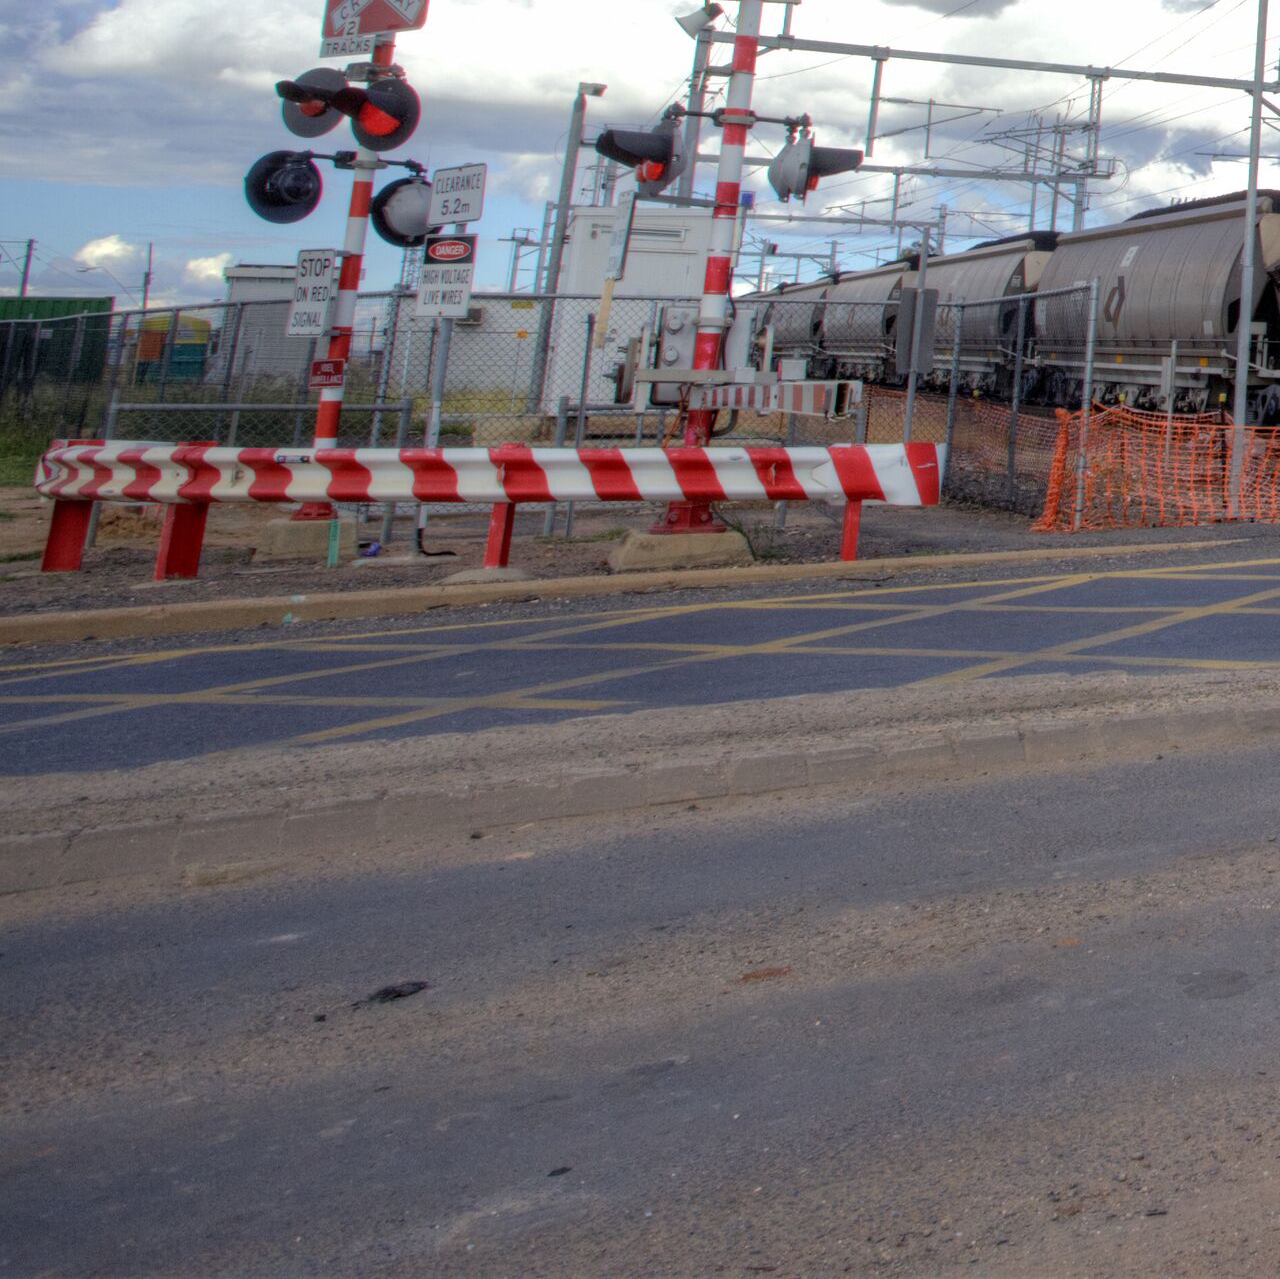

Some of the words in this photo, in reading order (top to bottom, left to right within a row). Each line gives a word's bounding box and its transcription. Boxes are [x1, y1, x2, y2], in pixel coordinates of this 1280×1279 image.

[346, 21, 356, 35] 2
[326, 40, 370, 54] TRACKS
[435, 173, 482, 194] CLEARANCE
[441, 198, 470, 215] 5.2m
[435, 244, 464, 256] DANGER
[301, 258, 331, 277] STOP
[422, 270, 439, 284] HIGH
[441, 268, 471, 284] VOLTAGE
[296, 286, 309, 302] ON
[311, 286, 329, 302] RED
[423, 290, 440, 305] LIVE
[440, 289, 463, 305] WIRES
[292, 312, 321, 327] SIGNAL
